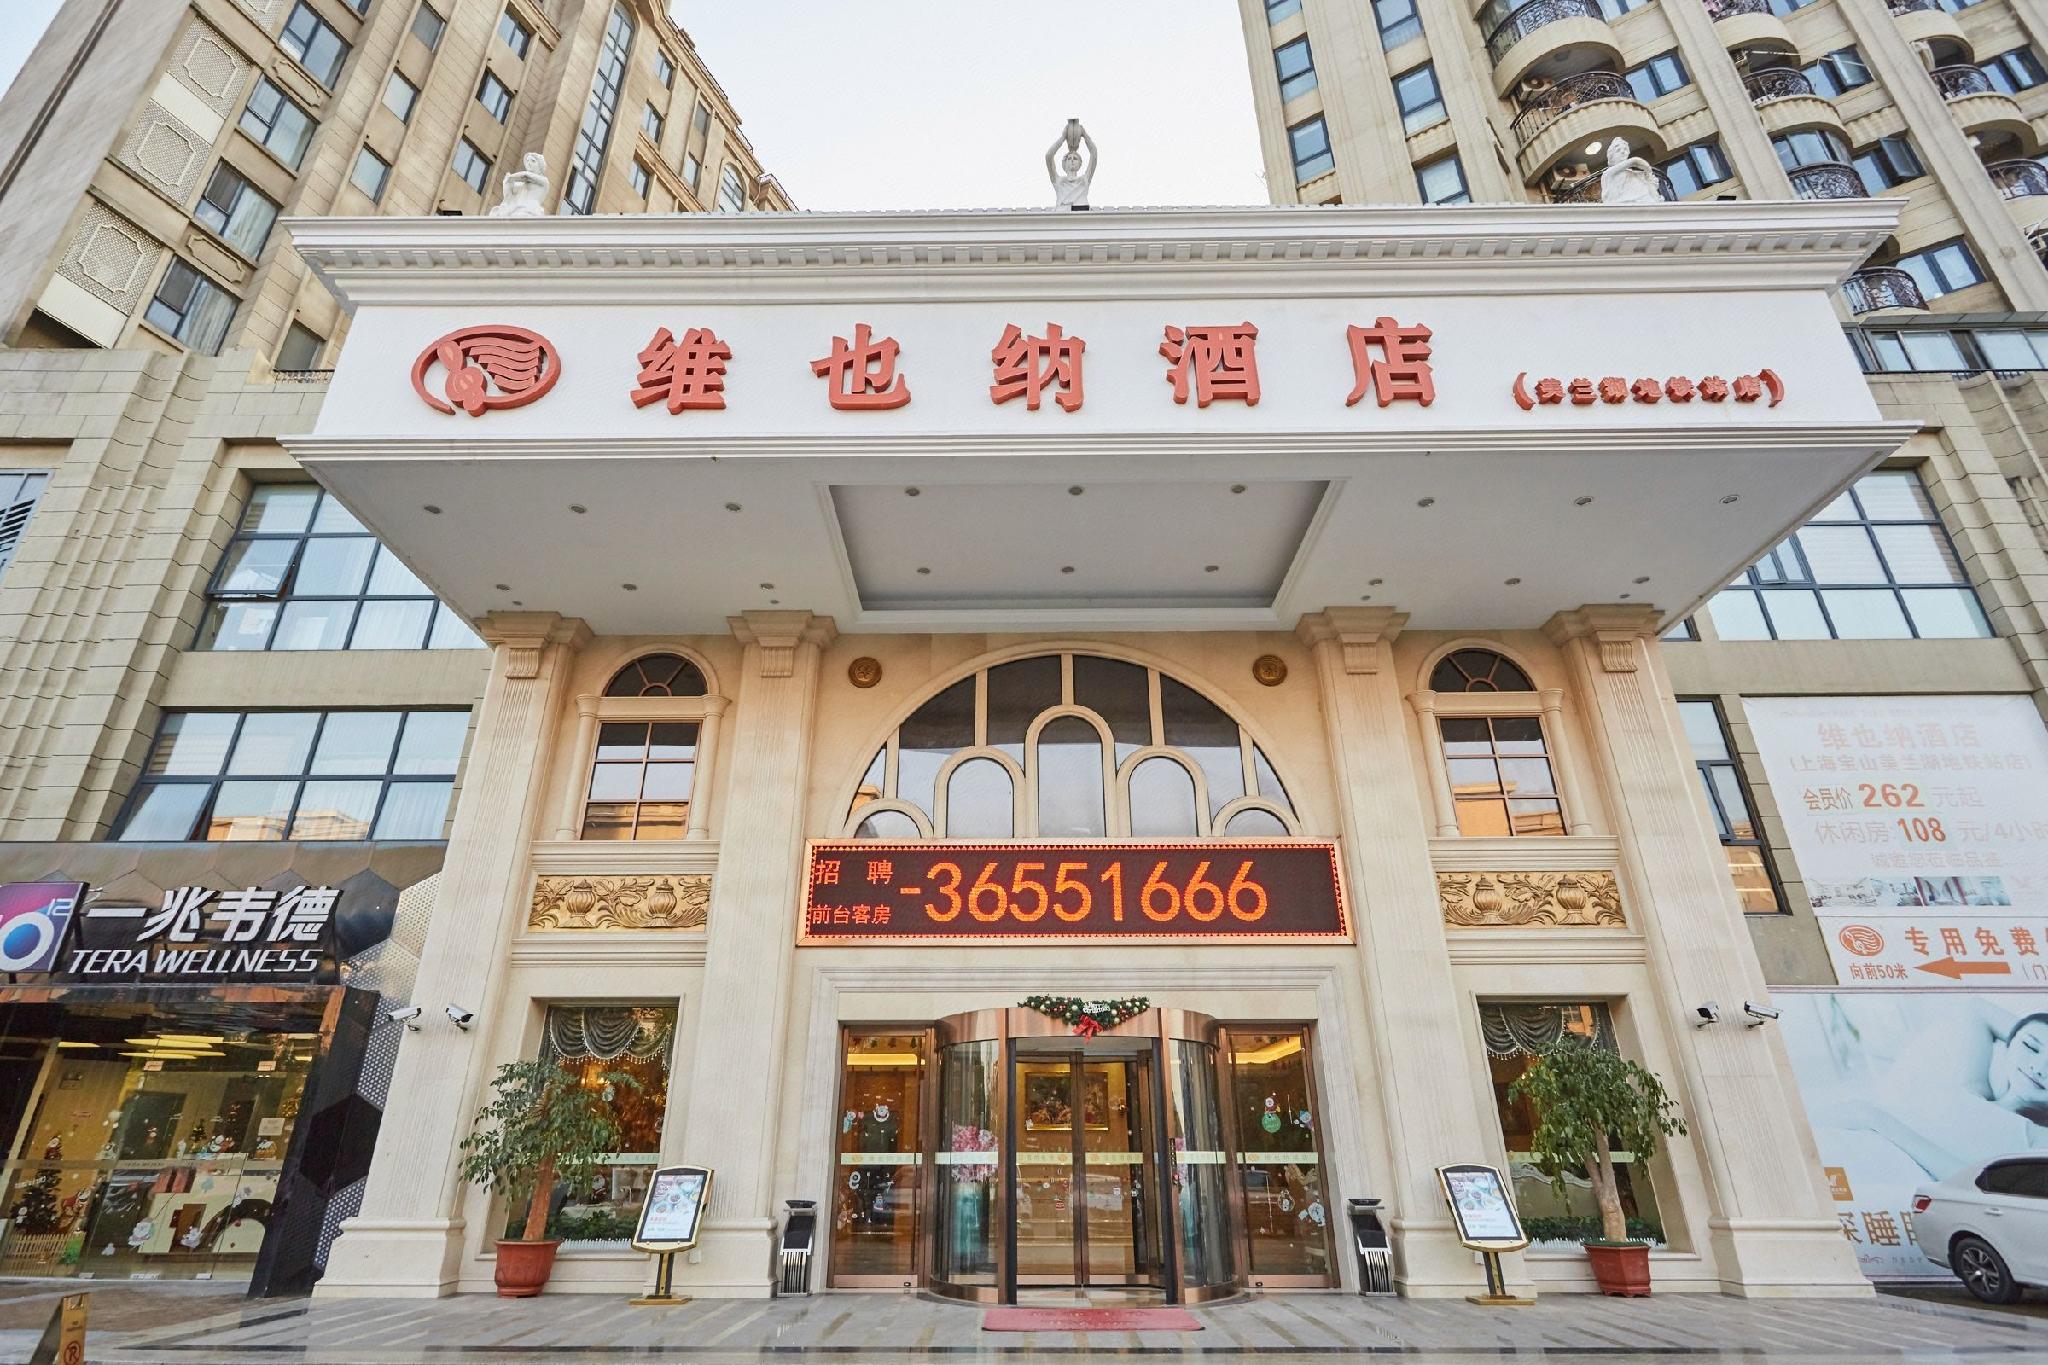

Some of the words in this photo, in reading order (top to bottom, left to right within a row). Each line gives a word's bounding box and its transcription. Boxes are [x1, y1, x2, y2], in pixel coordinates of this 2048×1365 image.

[630, 318, 1436, 413] 维也纳酒店
[1817, 723, 1980, 750] 维也纳酒店
[1803, 788, 1854, 811] 会员价
[1858, 783, 1926, 808] 262
[1897, 816, 1947, 843] 108
[900, 861, 1268, 922] -36551666
[87, 886, 339, 942] 一兆韦德
[811, 904, 891, 924] 前台客房
[1904, 926, 2048, 957] 专用免费
[68, 950, 147, 973] TERA
[153, 950, 323, 973] WELLNESS
[1850, 963, 1909, 980] 向前50米
